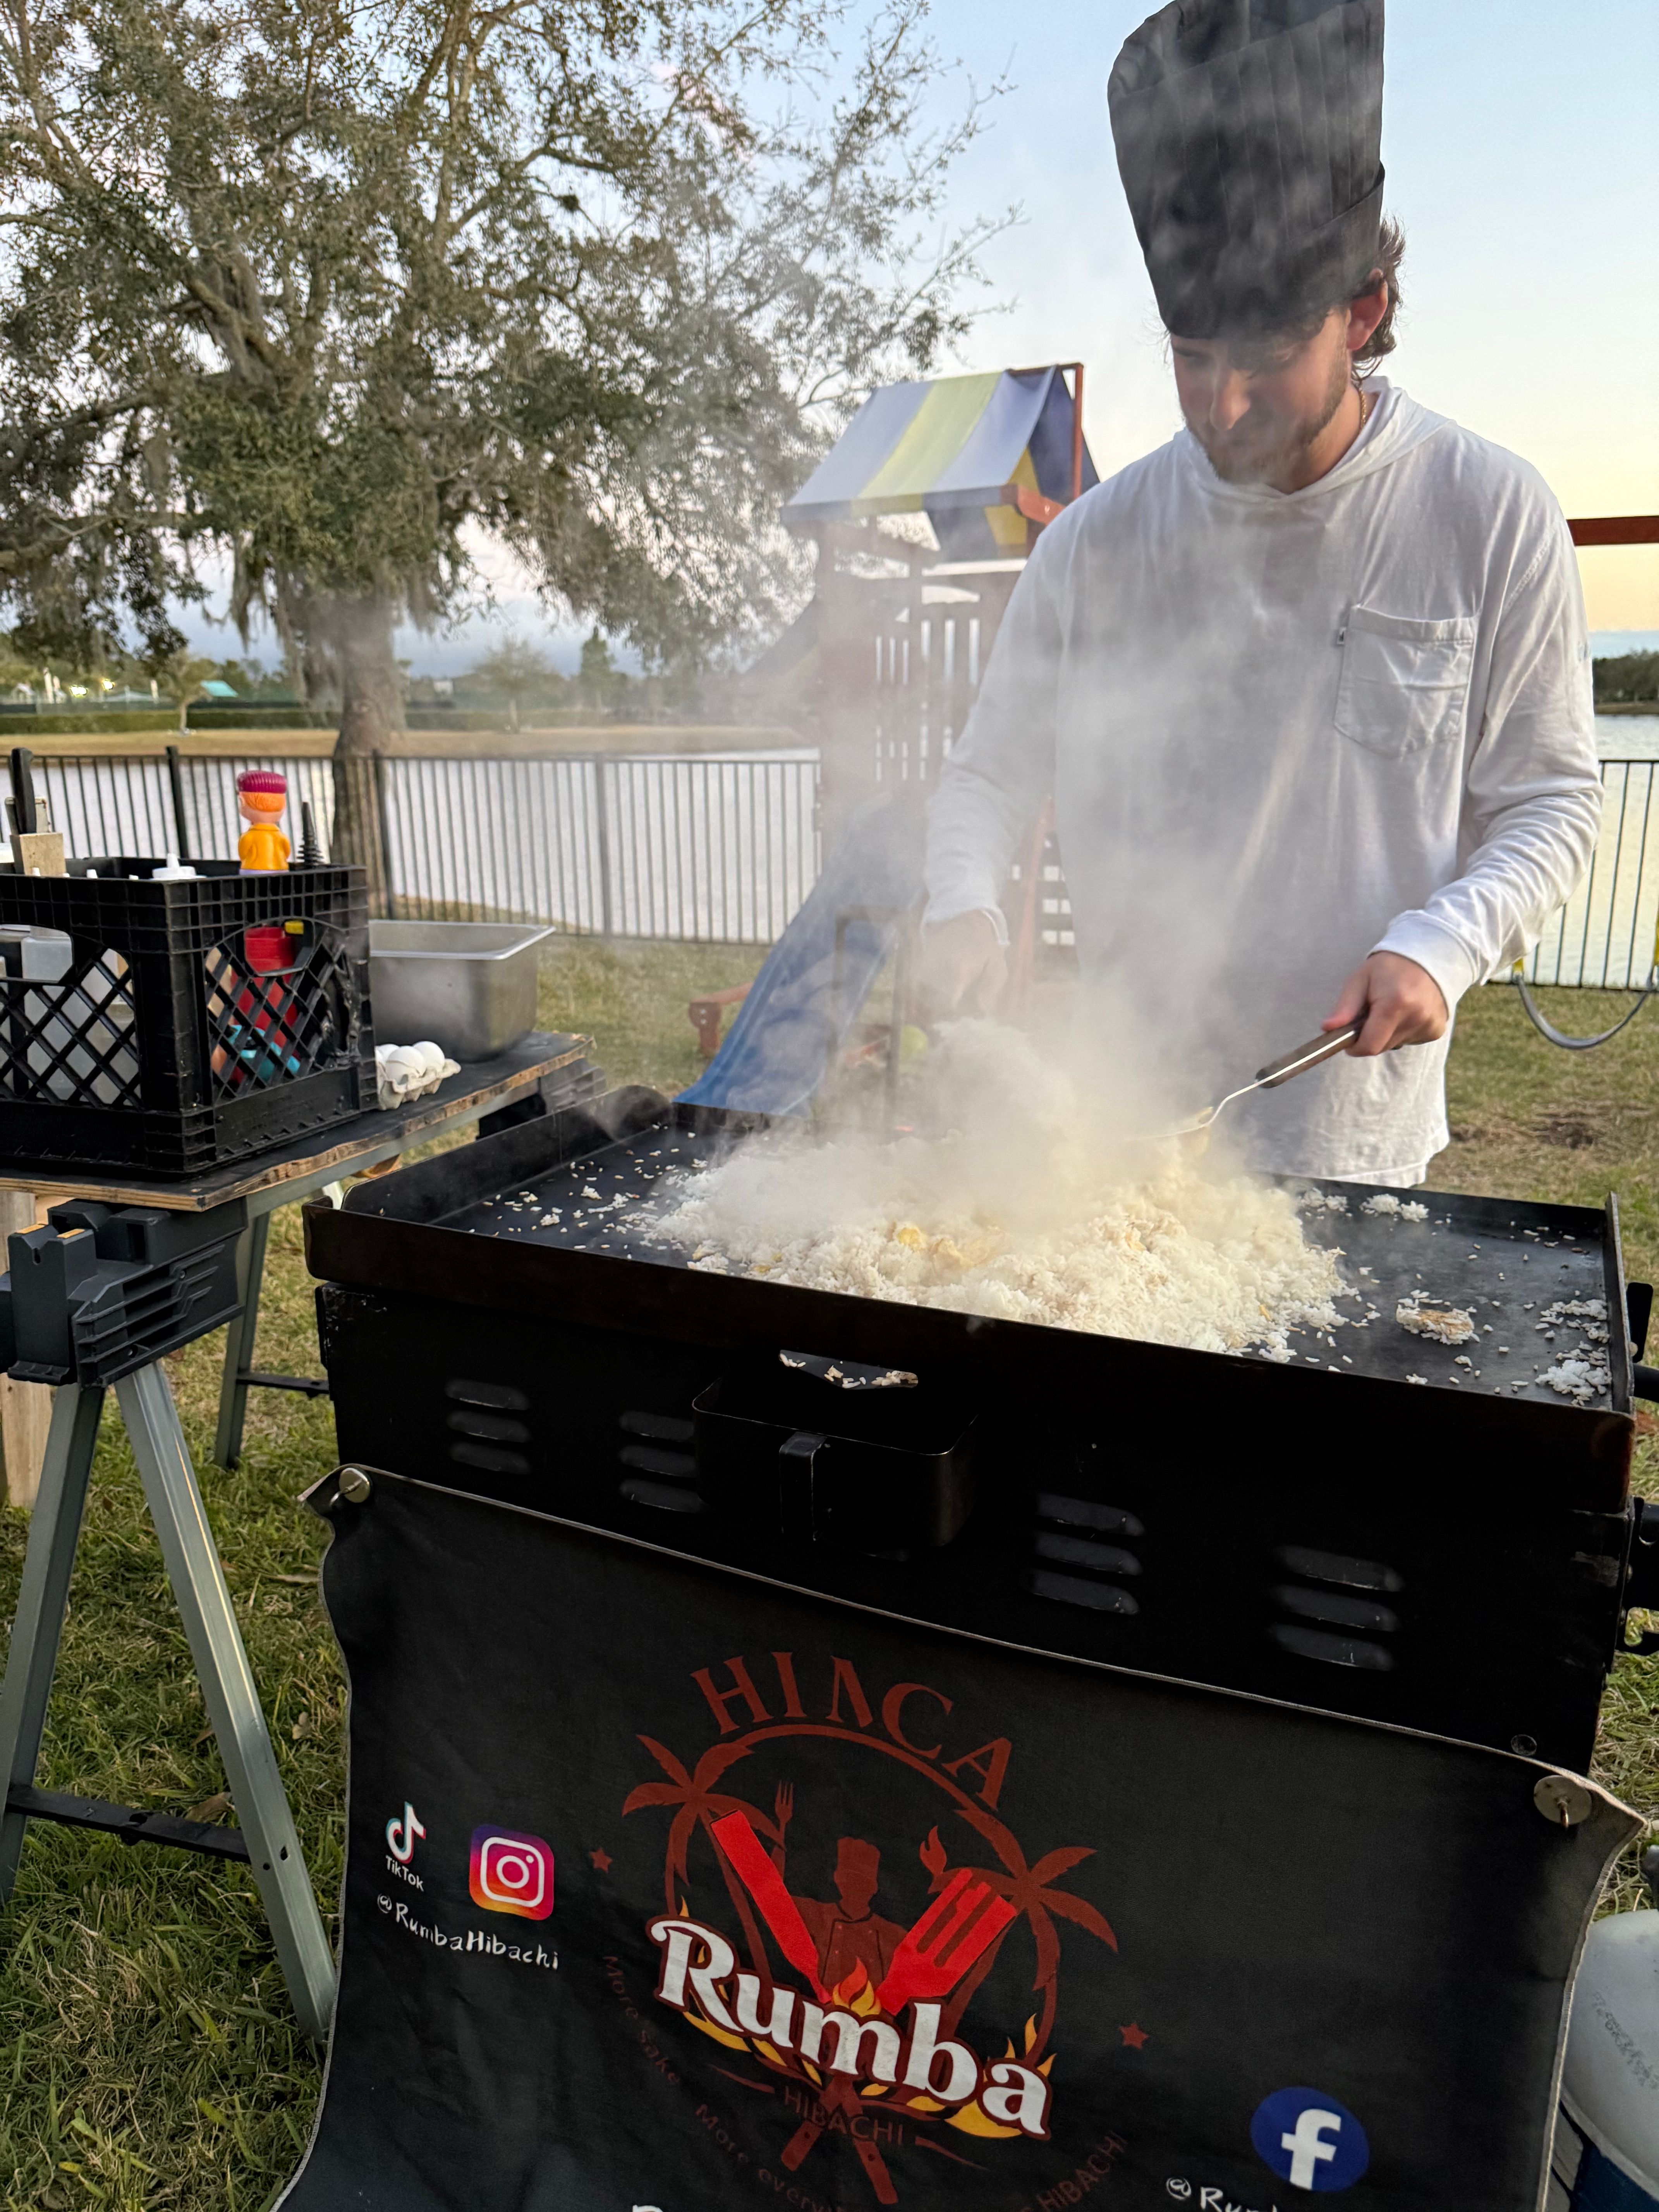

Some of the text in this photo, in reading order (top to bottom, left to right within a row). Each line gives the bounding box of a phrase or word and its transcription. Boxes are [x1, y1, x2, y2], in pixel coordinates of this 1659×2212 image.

[385, 1855, 424, 1891] TikTok
[651, 1920, 1046, 2135] Rumba
[784, 2085, 903, 2145] HIBACHI
[1036, 2130, 1128, 2212] HIBACHI
